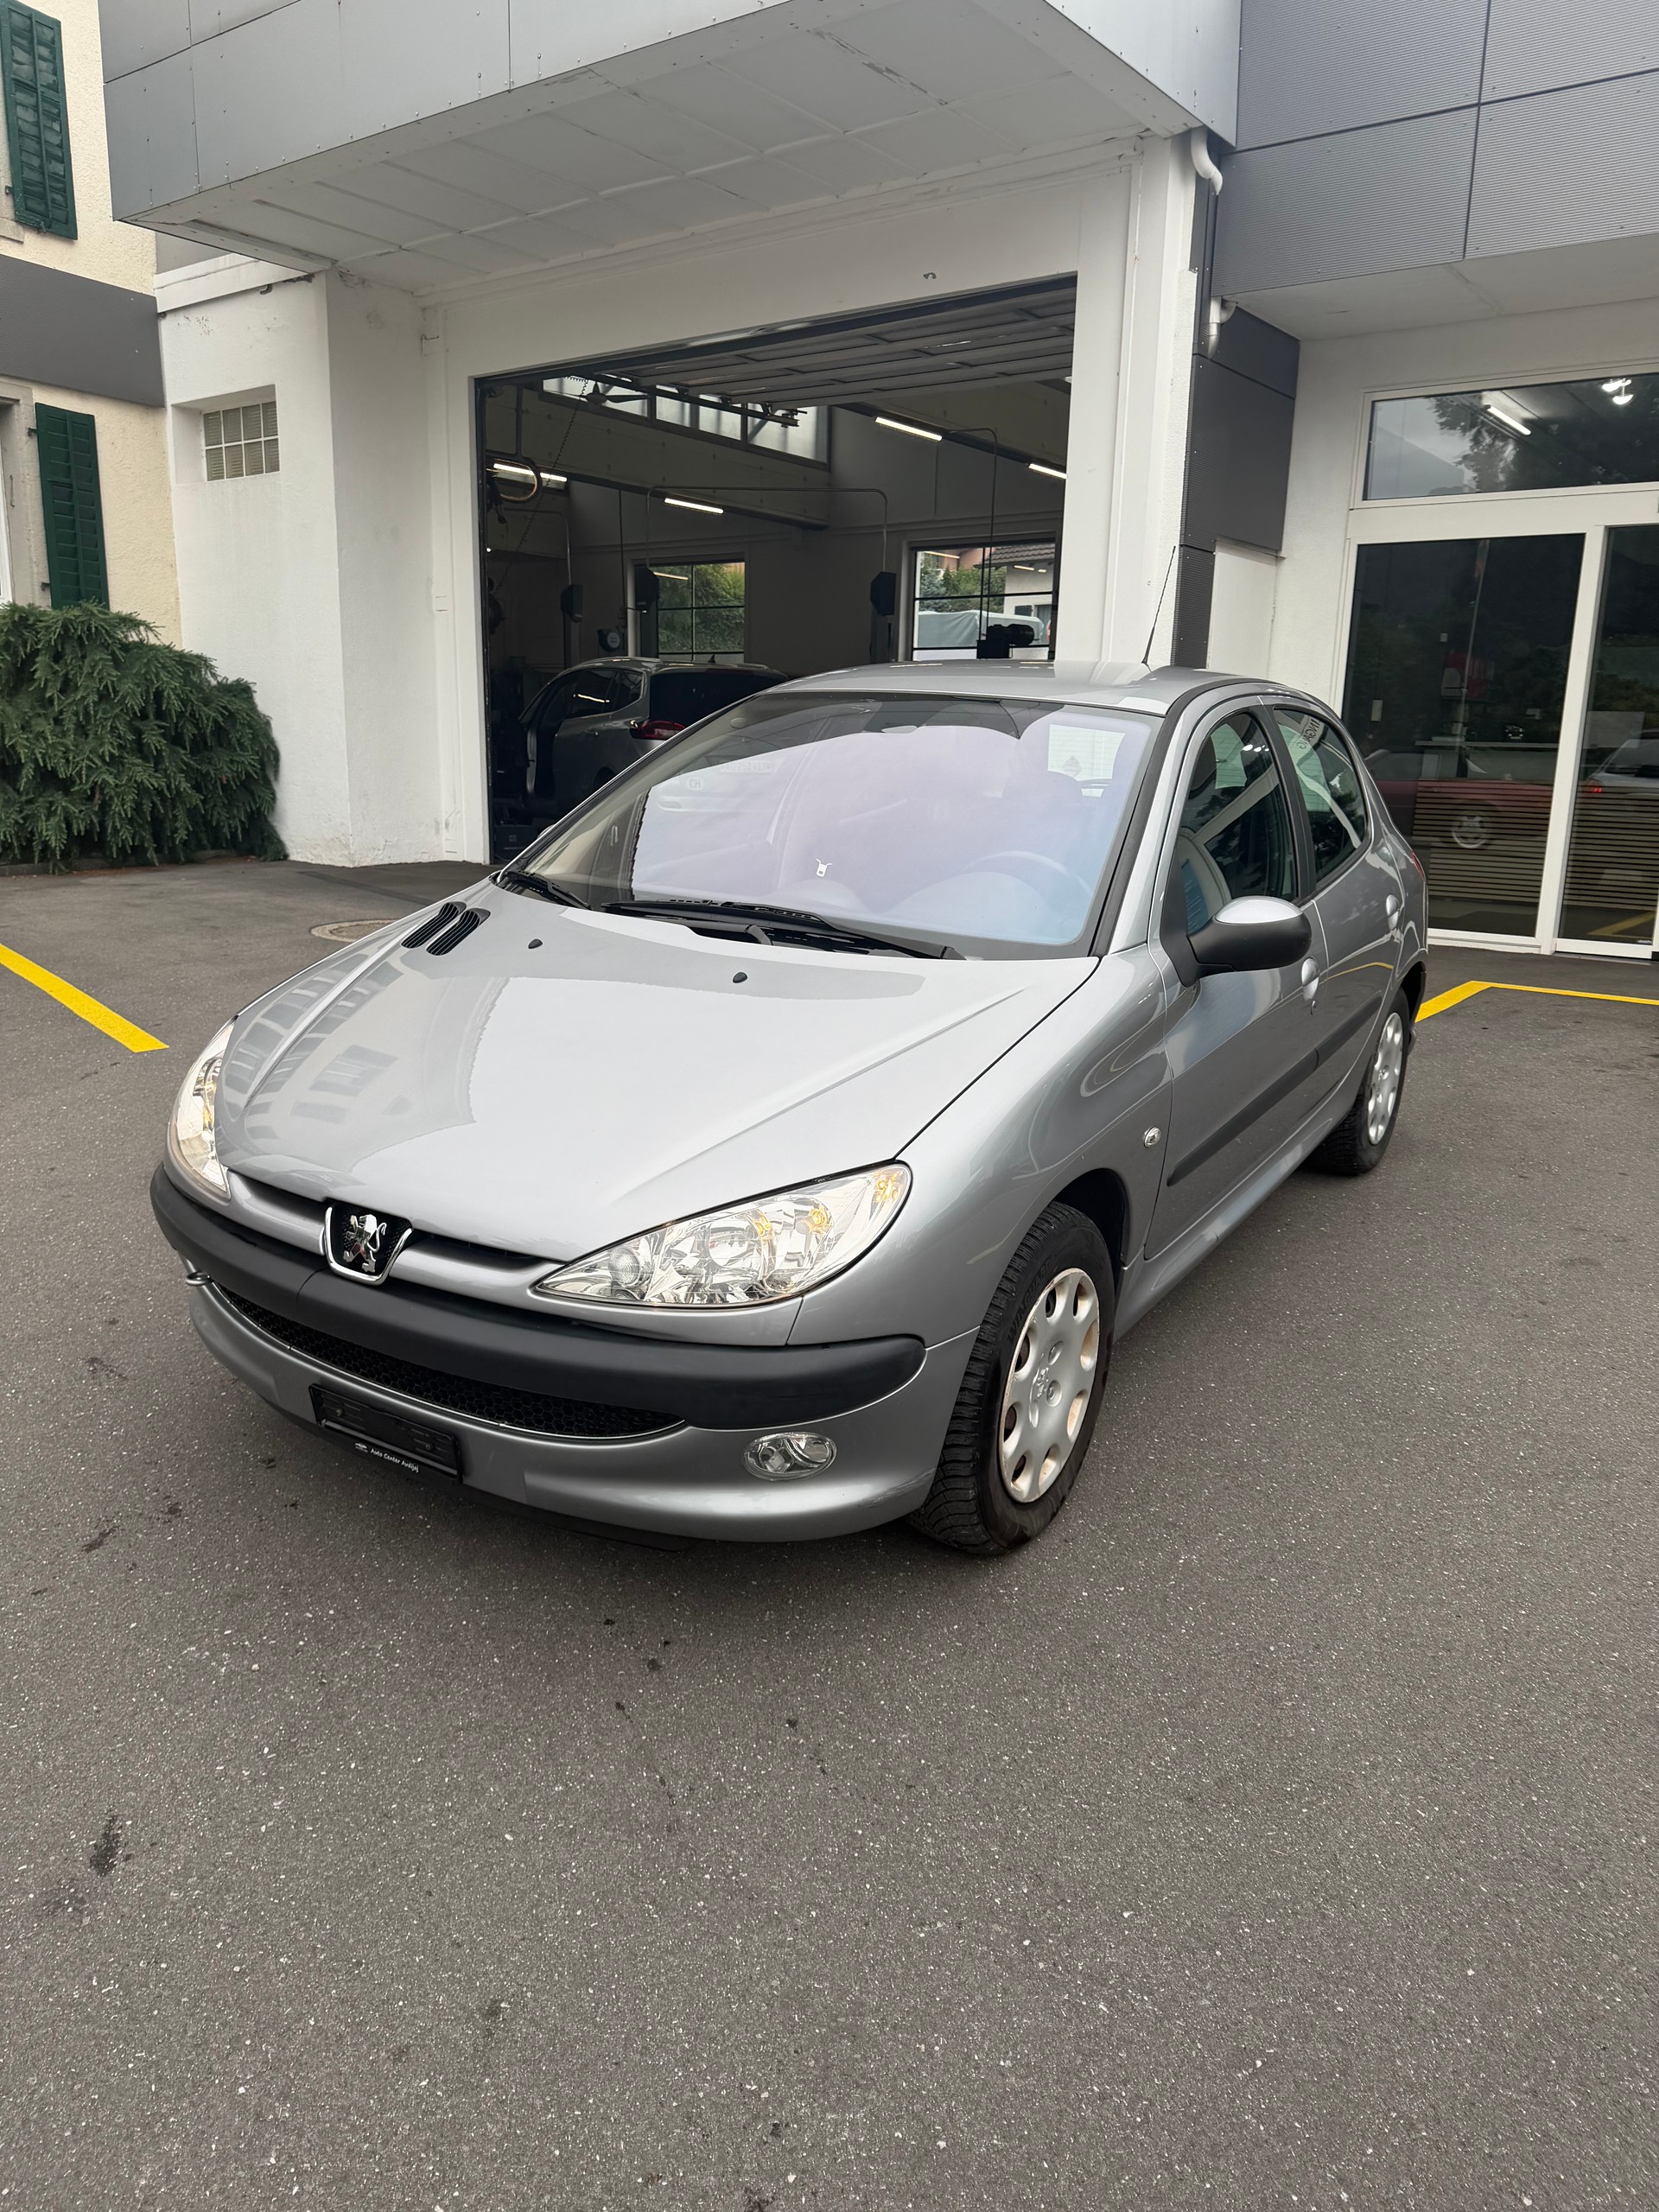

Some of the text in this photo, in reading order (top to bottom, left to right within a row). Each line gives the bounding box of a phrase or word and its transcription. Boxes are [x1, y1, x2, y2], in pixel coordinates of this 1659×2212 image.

[690, 779, 701, 789] CH
[371, 1448, 383, 1458] Auto
[384, 1453, 400, 1464] Center
